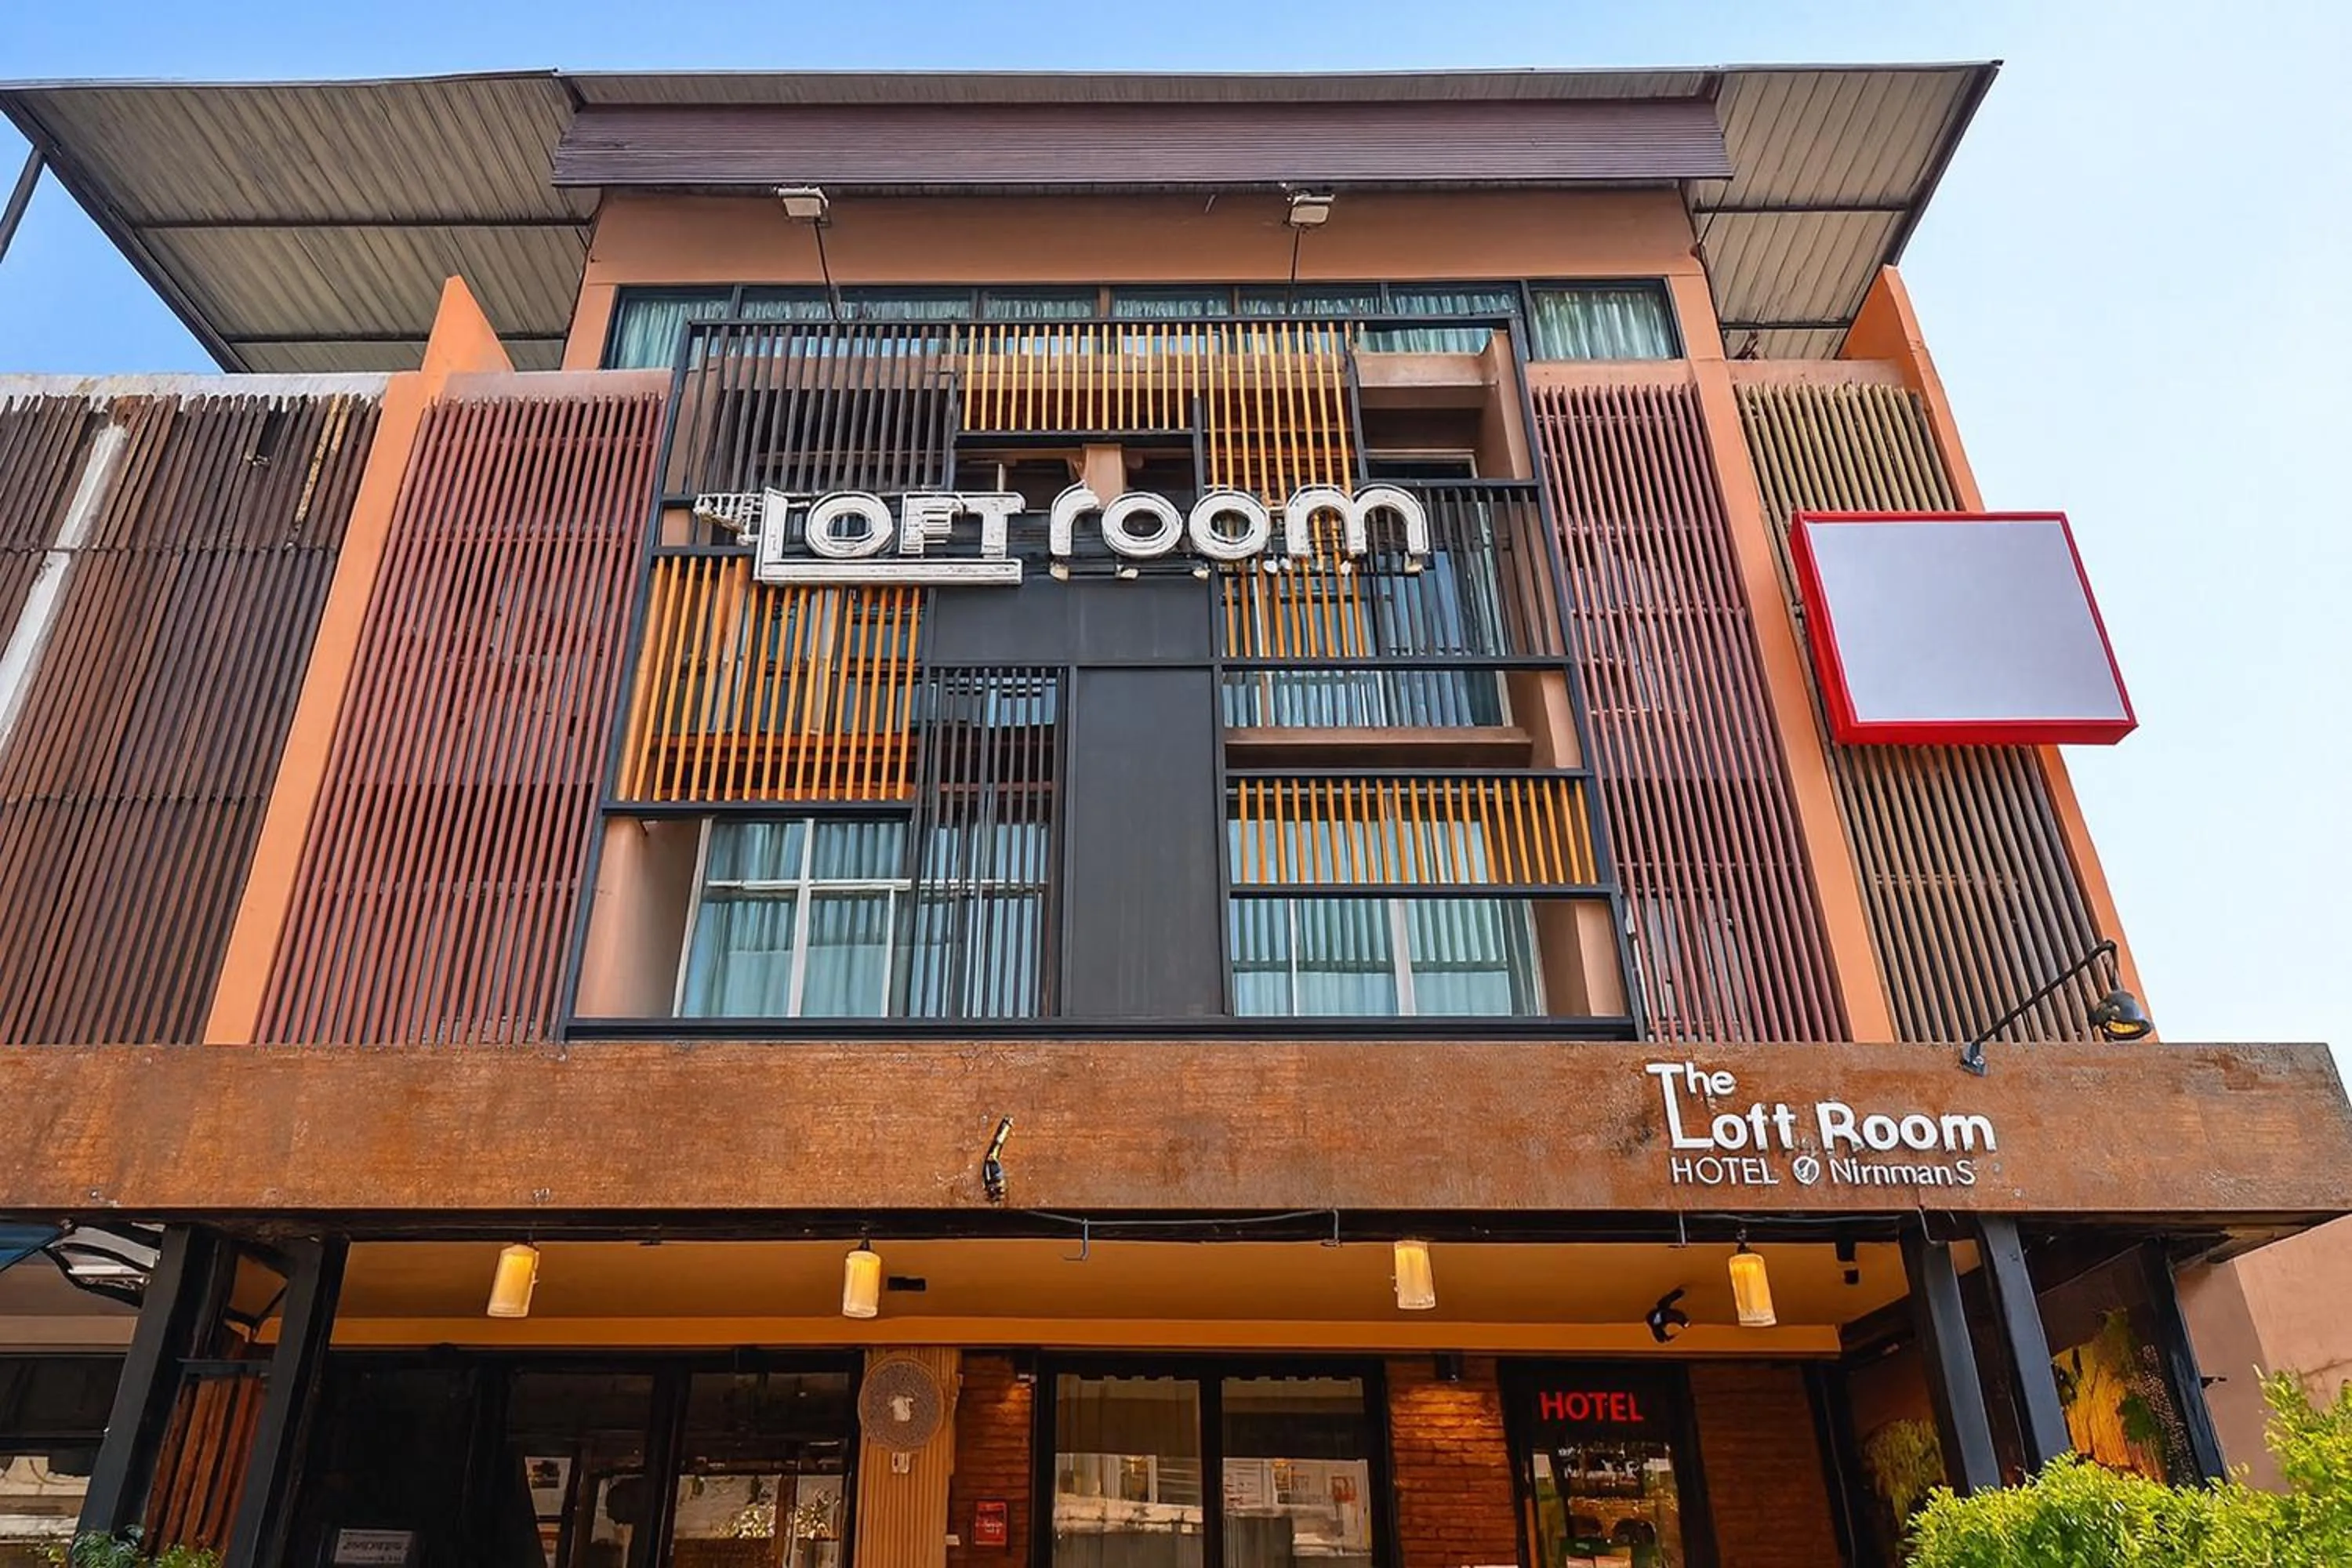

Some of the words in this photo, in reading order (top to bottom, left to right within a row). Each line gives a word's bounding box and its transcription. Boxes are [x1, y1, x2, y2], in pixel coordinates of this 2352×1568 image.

[1049, 480, 1430, 561] room
[1646, 1061, 1737, 1097] The
[1664, 1099, 1797, 1151] Loft
[1814, 1101, 1998, 1152] Room
[1671, 1156, 1780, 1185] HOTEL
[1539, 1391, 1645, 1421] HOTEL
